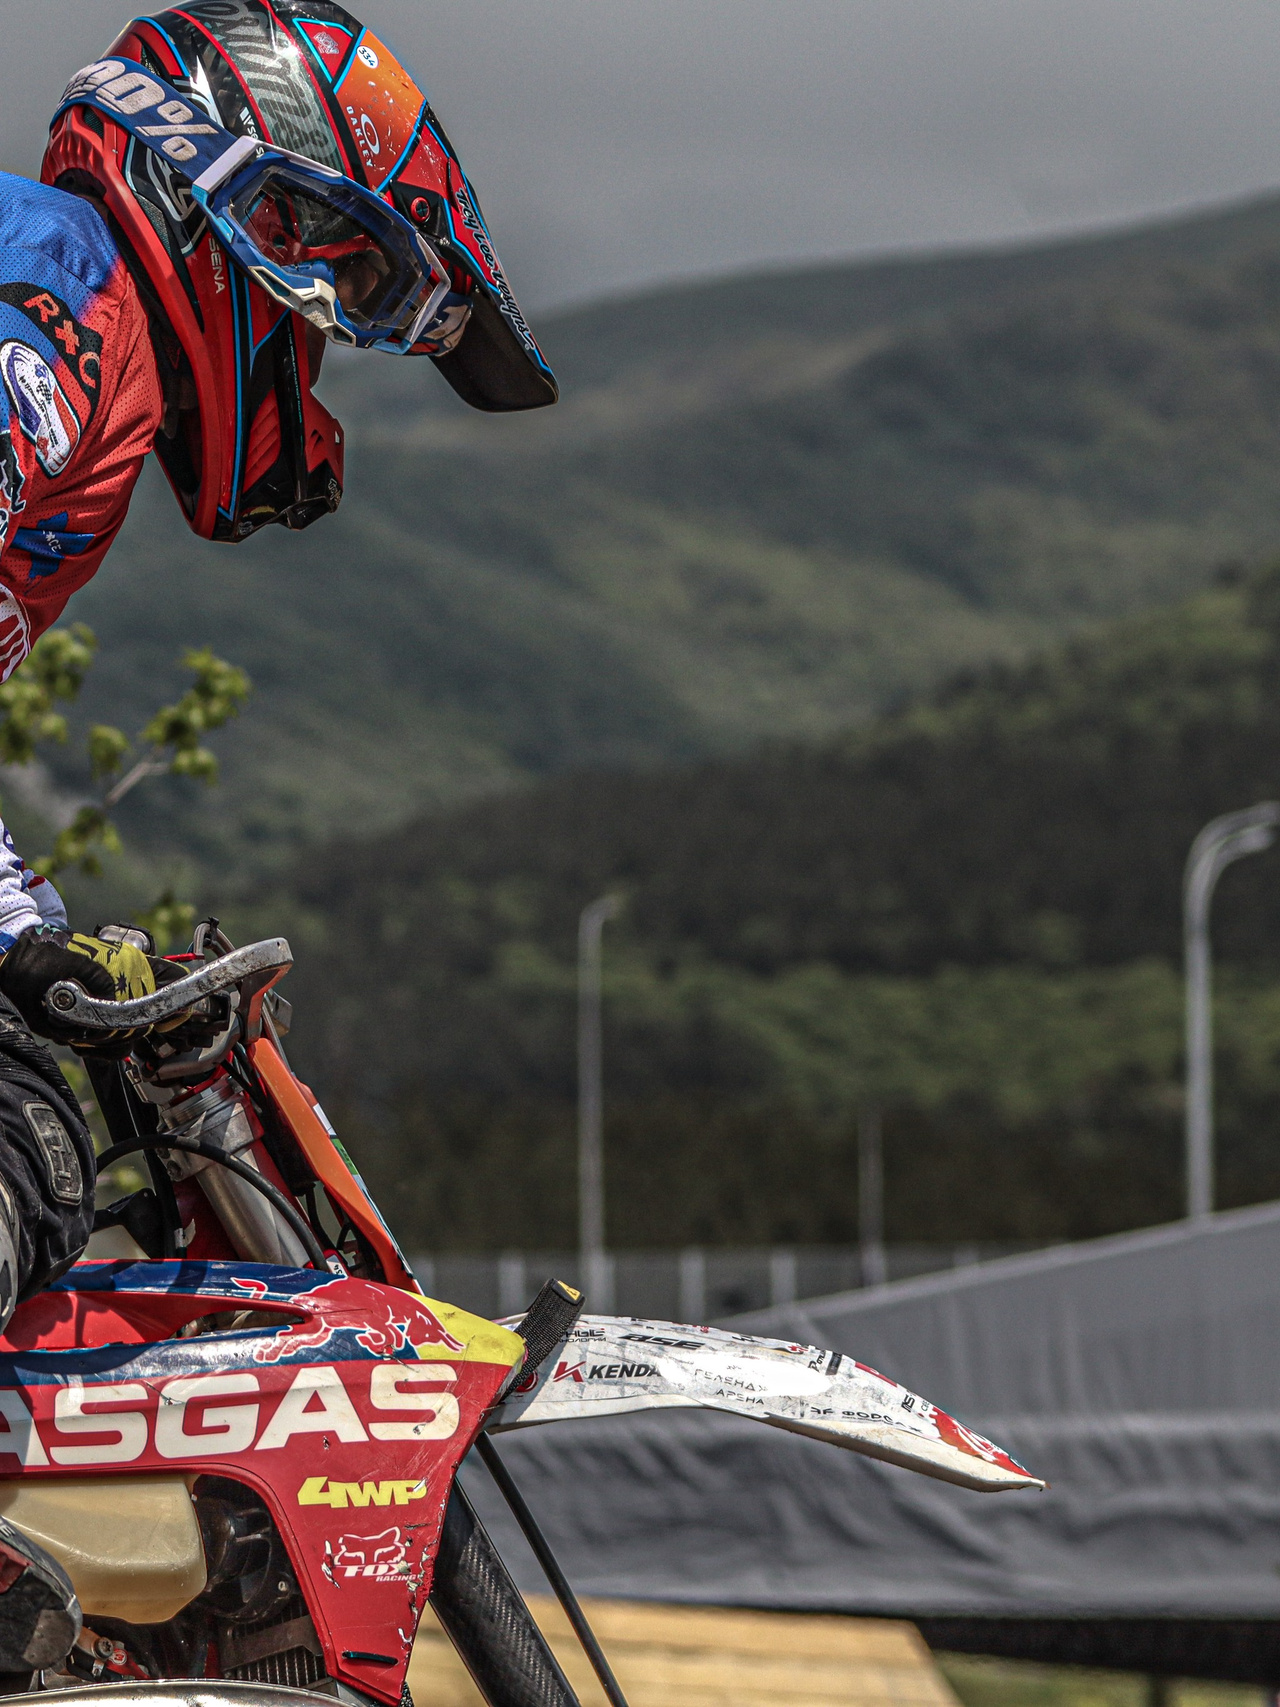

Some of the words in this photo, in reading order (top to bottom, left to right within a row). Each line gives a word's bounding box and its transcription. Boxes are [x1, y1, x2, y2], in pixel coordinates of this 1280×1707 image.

[346, 106, 373, 167] OAKLEY
[208, 238, 226, 294] SENA
[588, 1363, 661, 1379] KENDA
